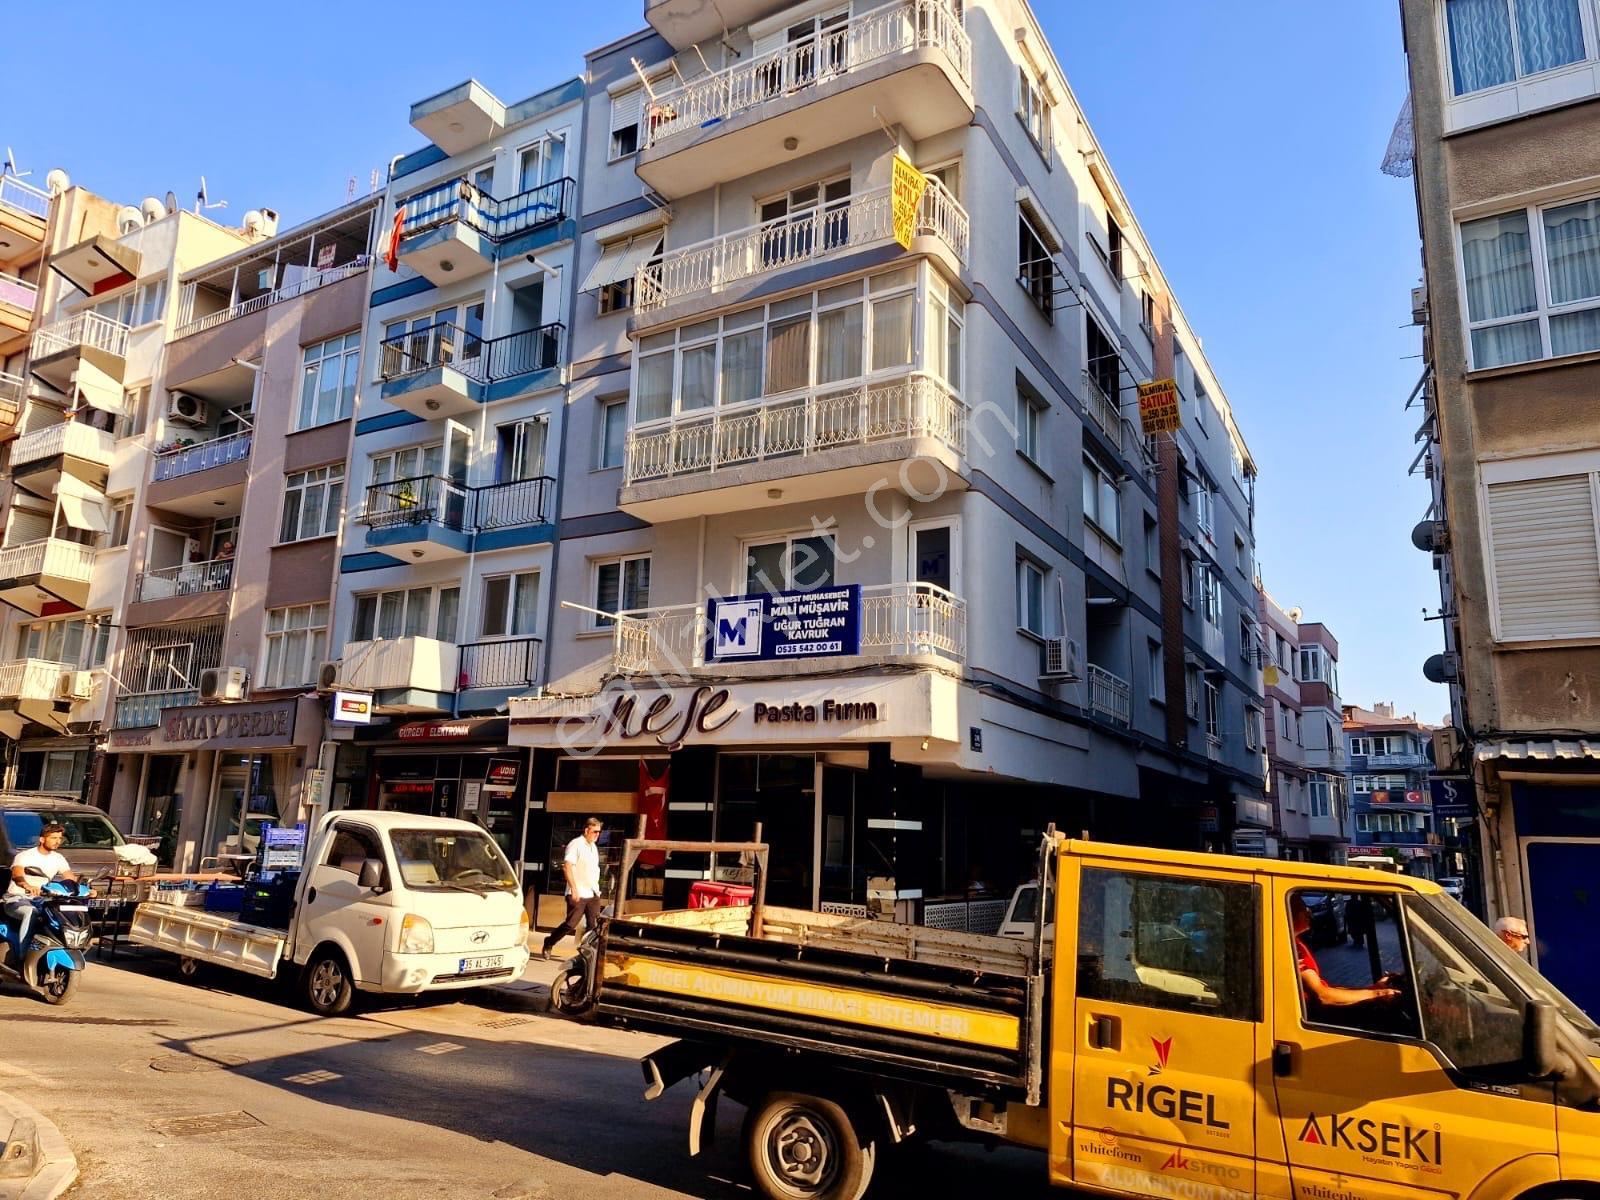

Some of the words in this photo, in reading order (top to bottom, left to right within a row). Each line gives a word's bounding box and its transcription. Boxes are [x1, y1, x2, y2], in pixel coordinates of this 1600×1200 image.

[1140, 391, 1176, 410] SATILIK
[771, 603, 797, 617] MALİ
[799, 600, 849, 616] MÜŞAVİR
[773, 619, 802, 631] UĞUR
[803, 616, 845, 629] TUĞRAN
[788, 628, 829, 640] KAVRUK
[777, 644, 797, 653] 0535
[799, 643, 814, 652] 542
[816, 643, 828, 651] 00
[830, 642, 839, 650] 61
[754, 701, 816, 724] Pasta
[226, 709, 289, 738] PERDE
[1079, 1140, 1142, 1163] whiteform
[1302, 1185, 1368, 1200] whiteplu
